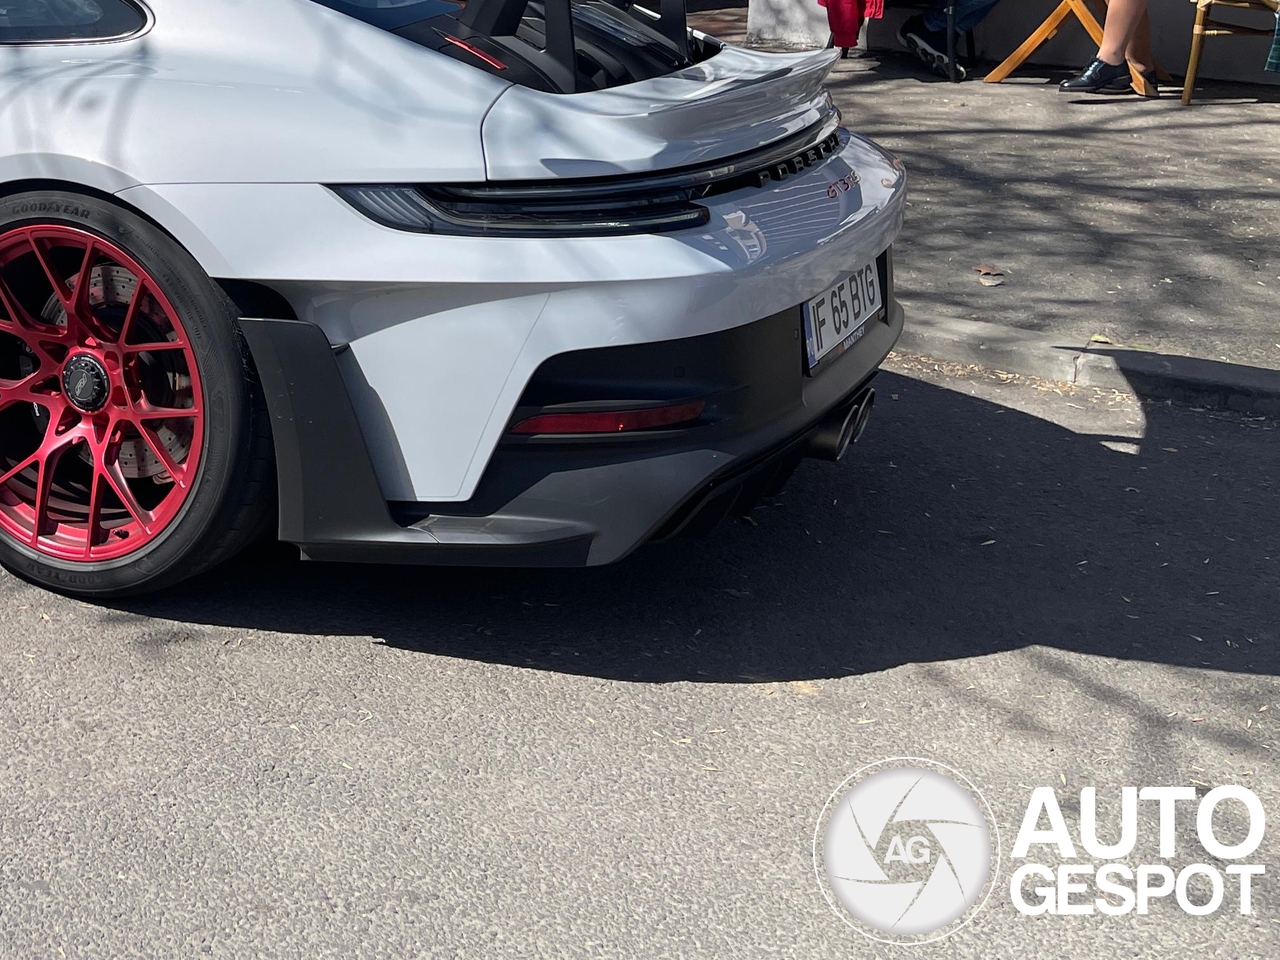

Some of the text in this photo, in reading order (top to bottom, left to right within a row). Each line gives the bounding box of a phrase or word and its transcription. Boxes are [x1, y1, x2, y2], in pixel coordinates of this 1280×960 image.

[812, 264, 875, 352] IF 65 BTG
